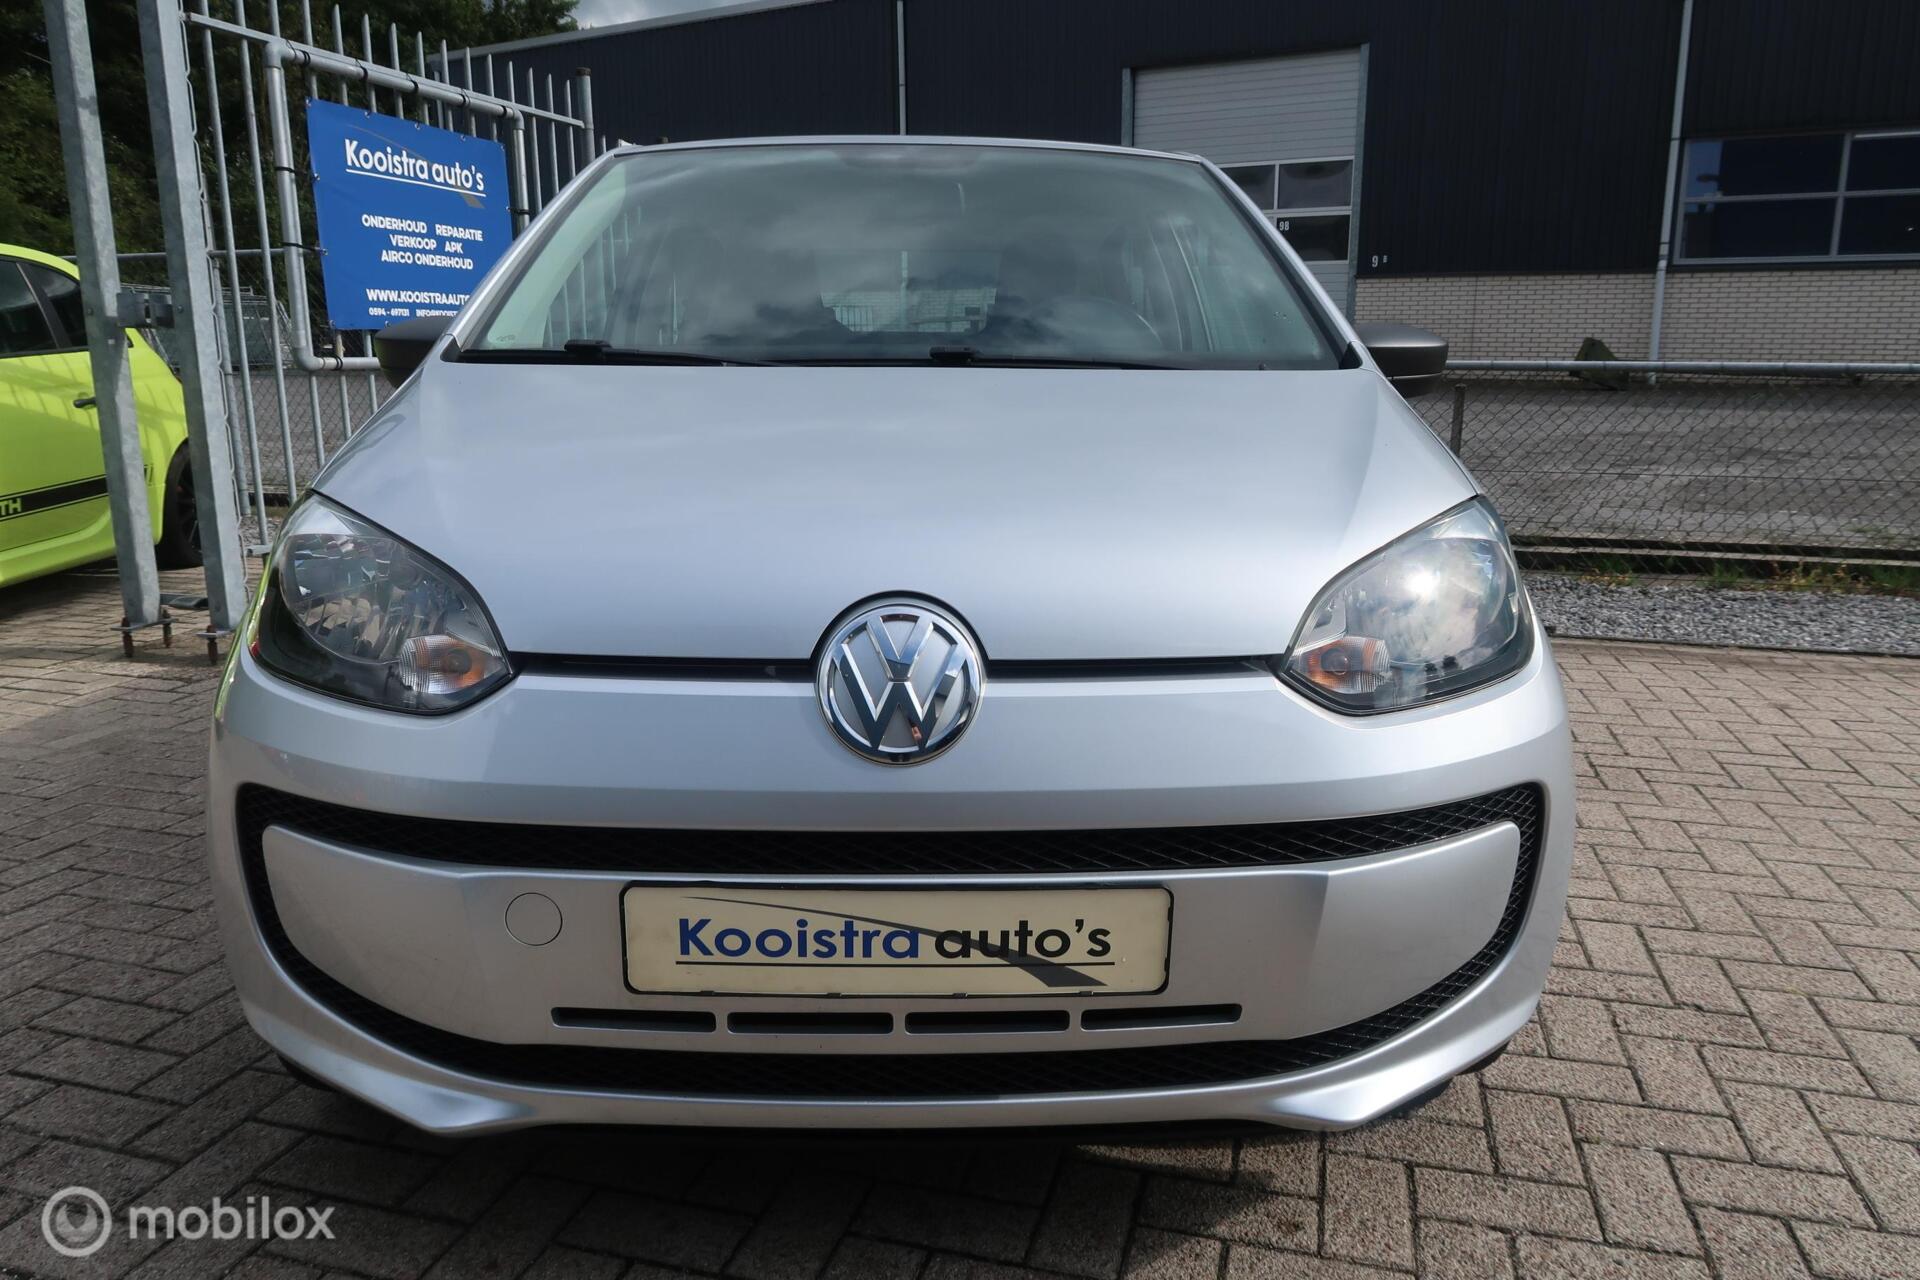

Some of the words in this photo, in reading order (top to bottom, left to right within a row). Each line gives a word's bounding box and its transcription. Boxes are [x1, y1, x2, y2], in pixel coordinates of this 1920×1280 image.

[345, 138, 429, 180] Kooistra
[432, 161, 484, 191] auto's
[362, 214, 427, 234] ONDERHOUD
[435, 224, 483, 241] REPARATIE
[389, 234, 437, 250] VERKOOP
[444, 241, 463, 254] APK
[381, 249, 413, 264] AIRCO
[415, 252, 473, 270] ONDERHOUD
[1371, 255, 1379, 268] 9
[678, 918, 920, 959] Kooistra
[934, 918, 1112, 959] auto's
